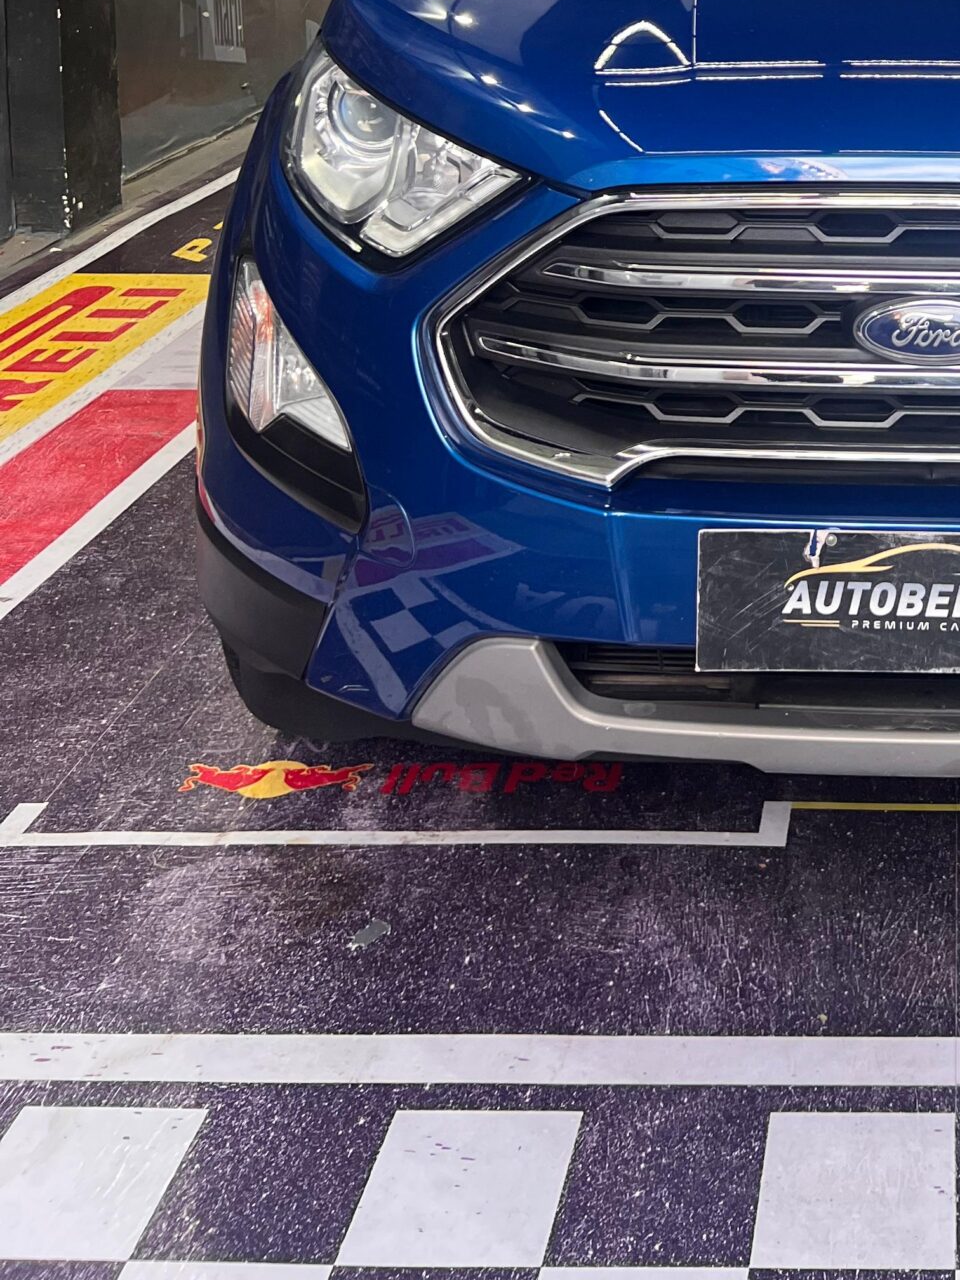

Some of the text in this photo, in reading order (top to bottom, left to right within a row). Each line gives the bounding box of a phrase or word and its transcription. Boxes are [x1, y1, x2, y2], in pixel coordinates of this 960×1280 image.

[851, 619, 931, 632] PREMIUM
[379, 760, 624, 795] Red Bull
